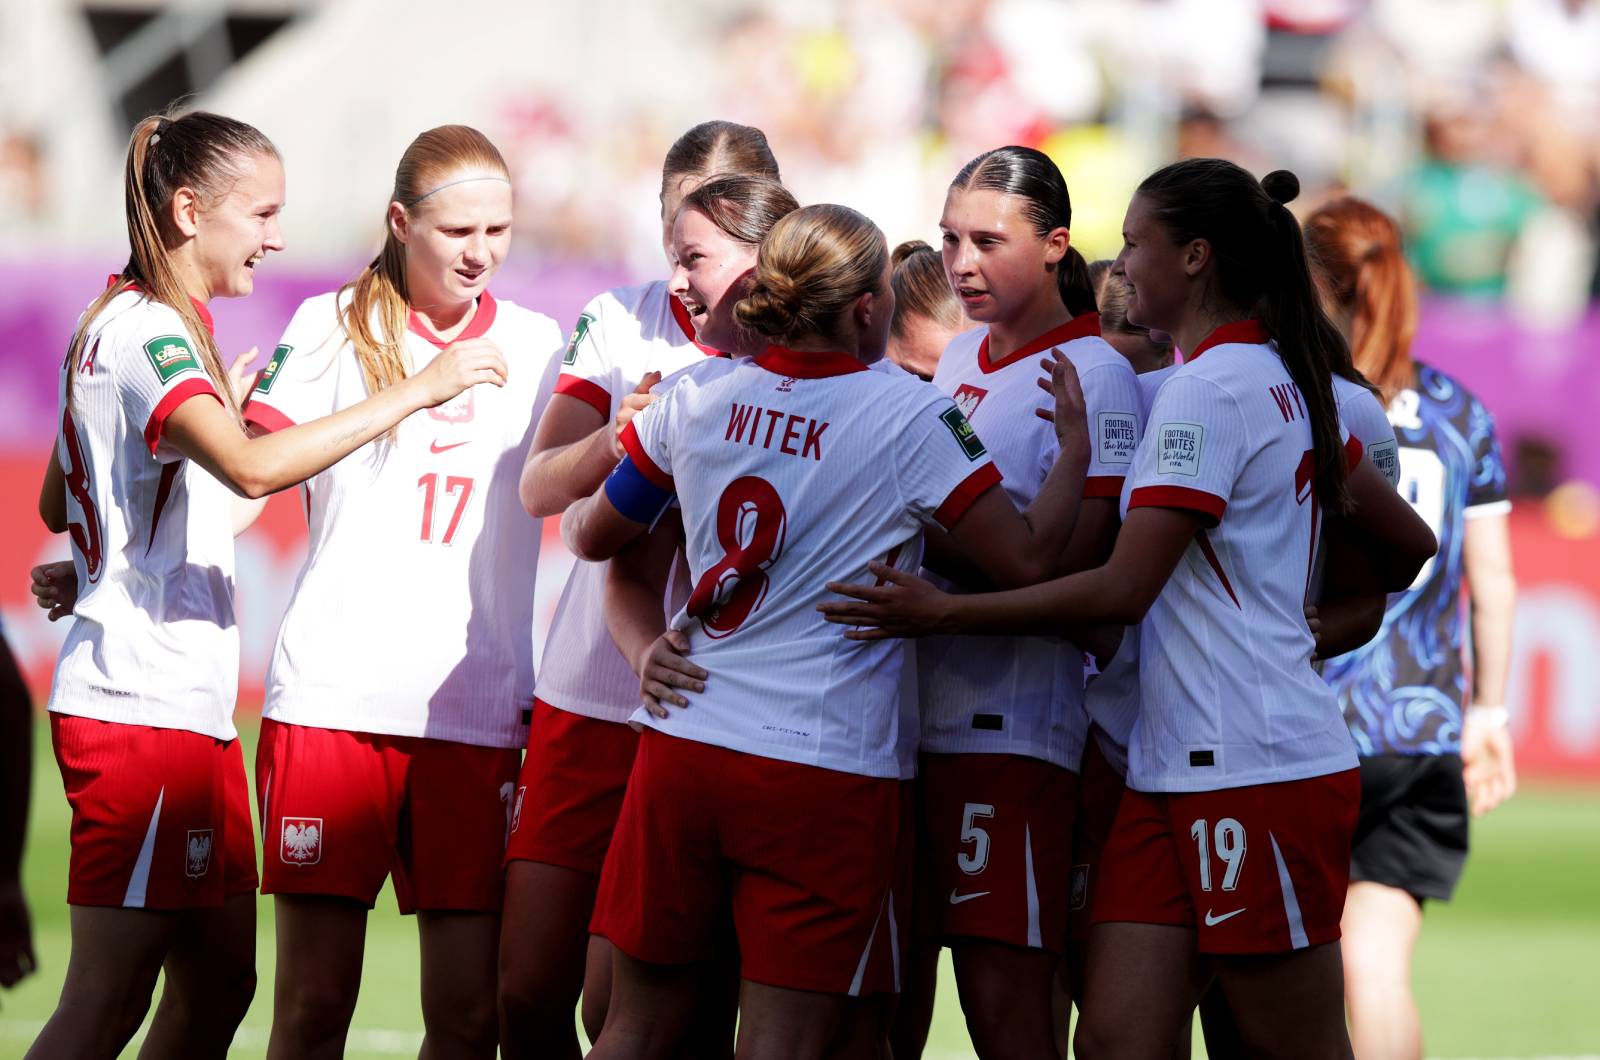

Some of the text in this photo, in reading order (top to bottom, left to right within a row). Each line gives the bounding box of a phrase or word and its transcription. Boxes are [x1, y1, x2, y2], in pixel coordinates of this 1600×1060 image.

[1105, 419, 1134, 429] FOOTBALL
[725, 403, 829, 461] WITEK
[1105, 428, 1134, 440] UNITES
[1164, 429, 1195, 440] FOOTBALL
[1104, 440, 1116, 450] the
[1164, 439, 1195, 452] UNITES
[1163, 450, 1195, 462] the World
[418, 472, 476, 547] 17
[686, 475, 787, 639] 8
[958, 802, 995, 876] 5
[1191, 818, 1247, 892] 19
